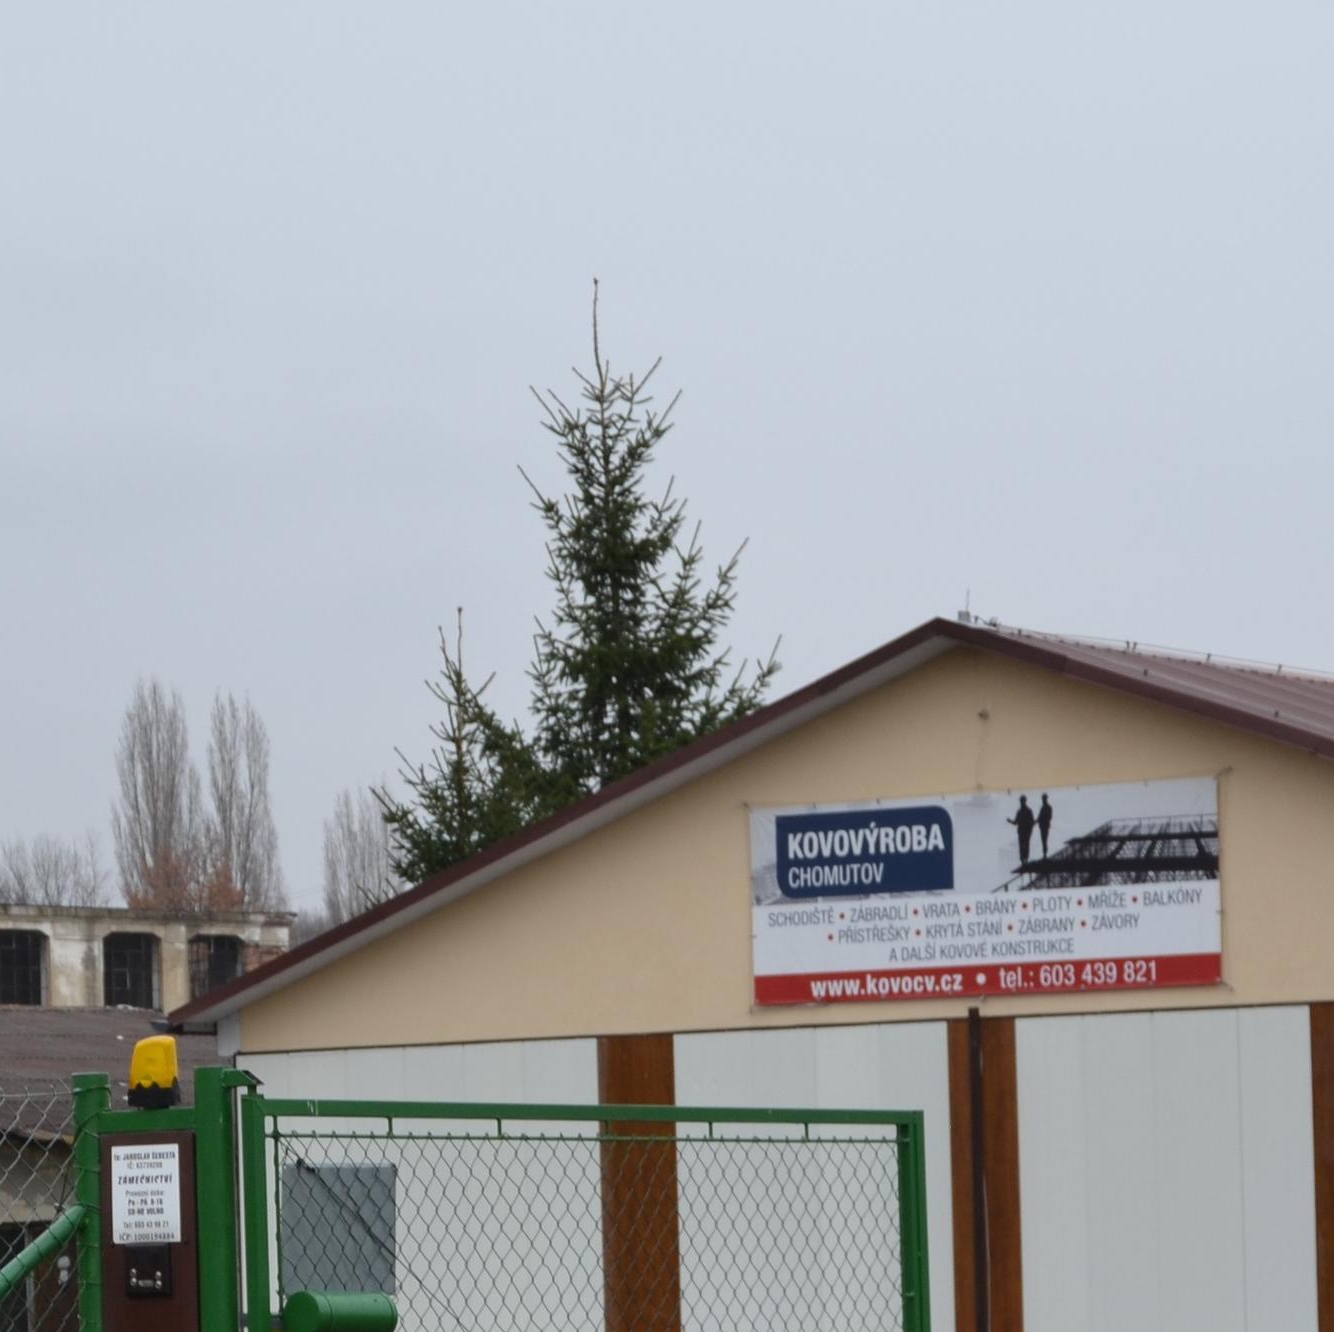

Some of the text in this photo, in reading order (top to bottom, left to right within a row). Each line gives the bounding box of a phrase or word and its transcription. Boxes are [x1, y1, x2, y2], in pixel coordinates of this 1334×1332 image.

[787, 821, 945, 860] KOVOVÝROBA
[788, 861, 884, 888] CHOMUTOV
[849, 901, 908, 923] ZÁBRADLÍ
[922, 901, 960, 918] VRATA
[975, 896, 1017, 916] BRÁNY
[1032, 896, 1072, 913] PLOTY
[1088, 888, 1127, 910] MŘÍŽE
[837, 910, 1140, 944] PŘÍSTŘEŠKY KRYTÁ STÁNÍ ZÁBRANY ZÁVORY
[889, 938, 1075, 962] A DALŠÍ KOVOVÉ KONSTRUKCE
[810, 959, 1158, 998] www.kovocv.cz tel.: 603 439 821
[118, 1174, 172, 1184] ZÁMEČNICTVÍ
